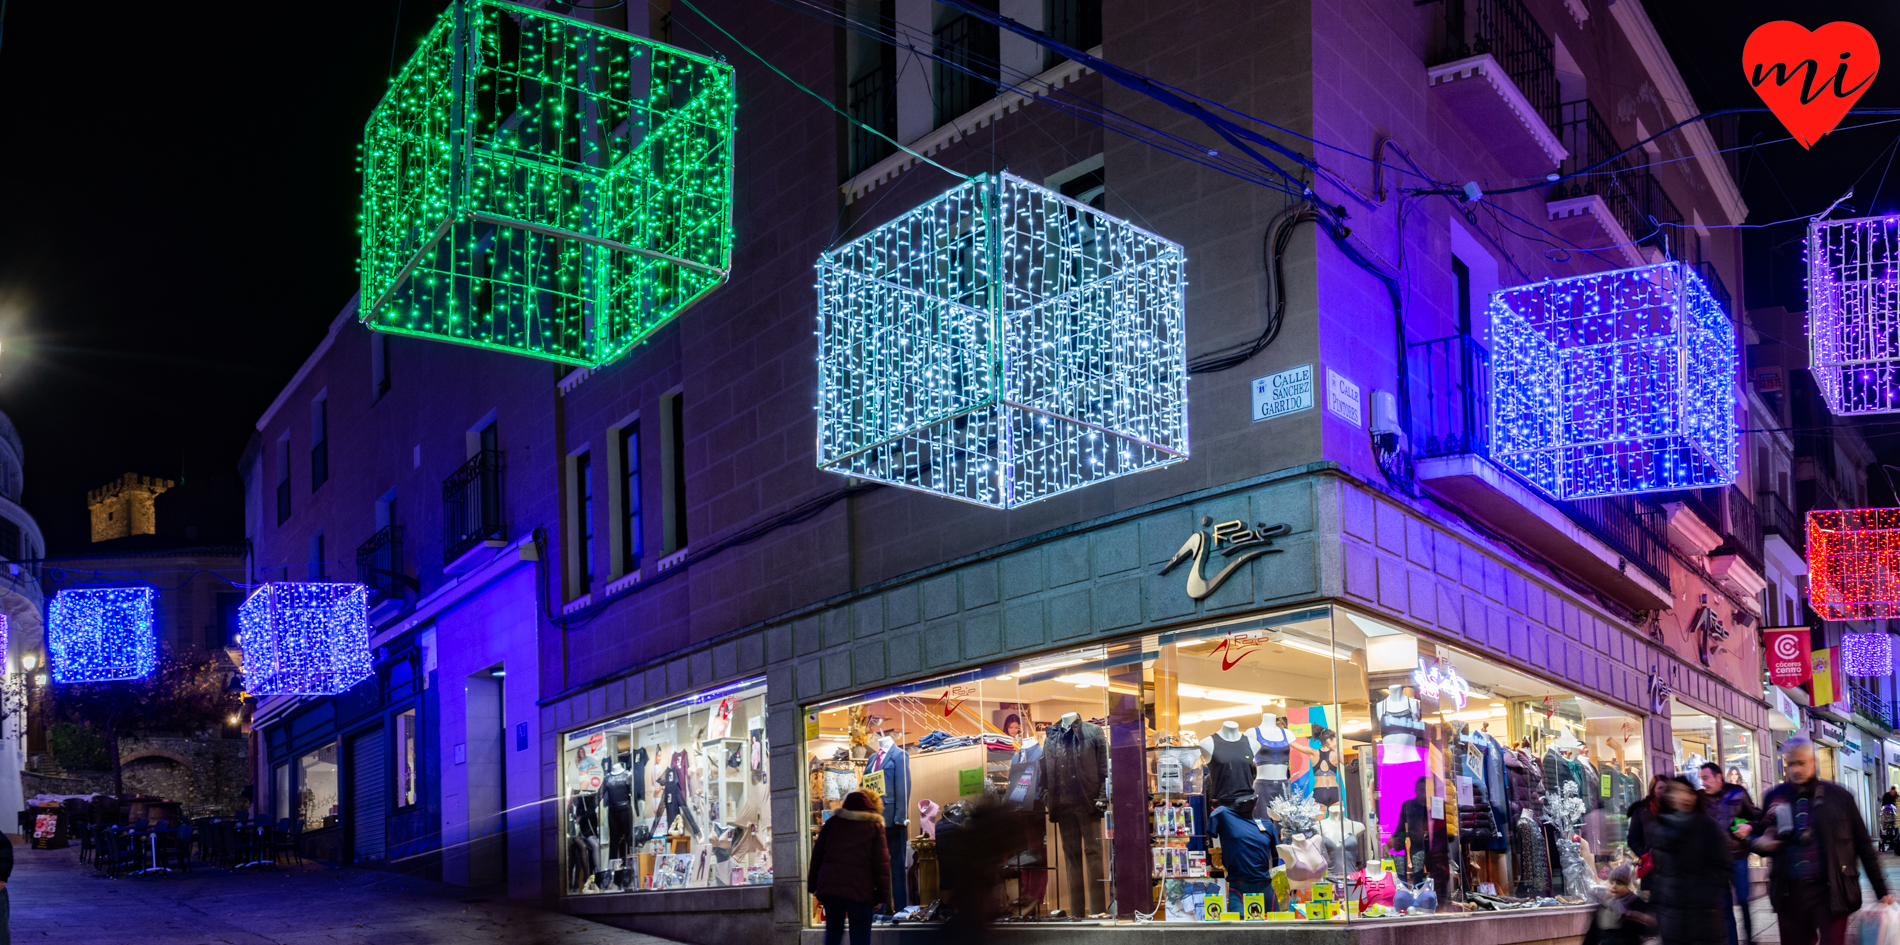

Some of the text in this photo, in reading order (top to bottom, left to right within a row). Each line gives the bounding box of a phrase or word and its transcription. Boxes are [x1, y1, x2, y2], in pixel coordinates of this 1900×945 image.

[1272, 370, 1309, 388] CALLE
[1339, 379, 1359, 403] CALLE
[1261, 396, 1302, 416] GARRIDO
[1332, 393, 1359, 423] PINTORES
